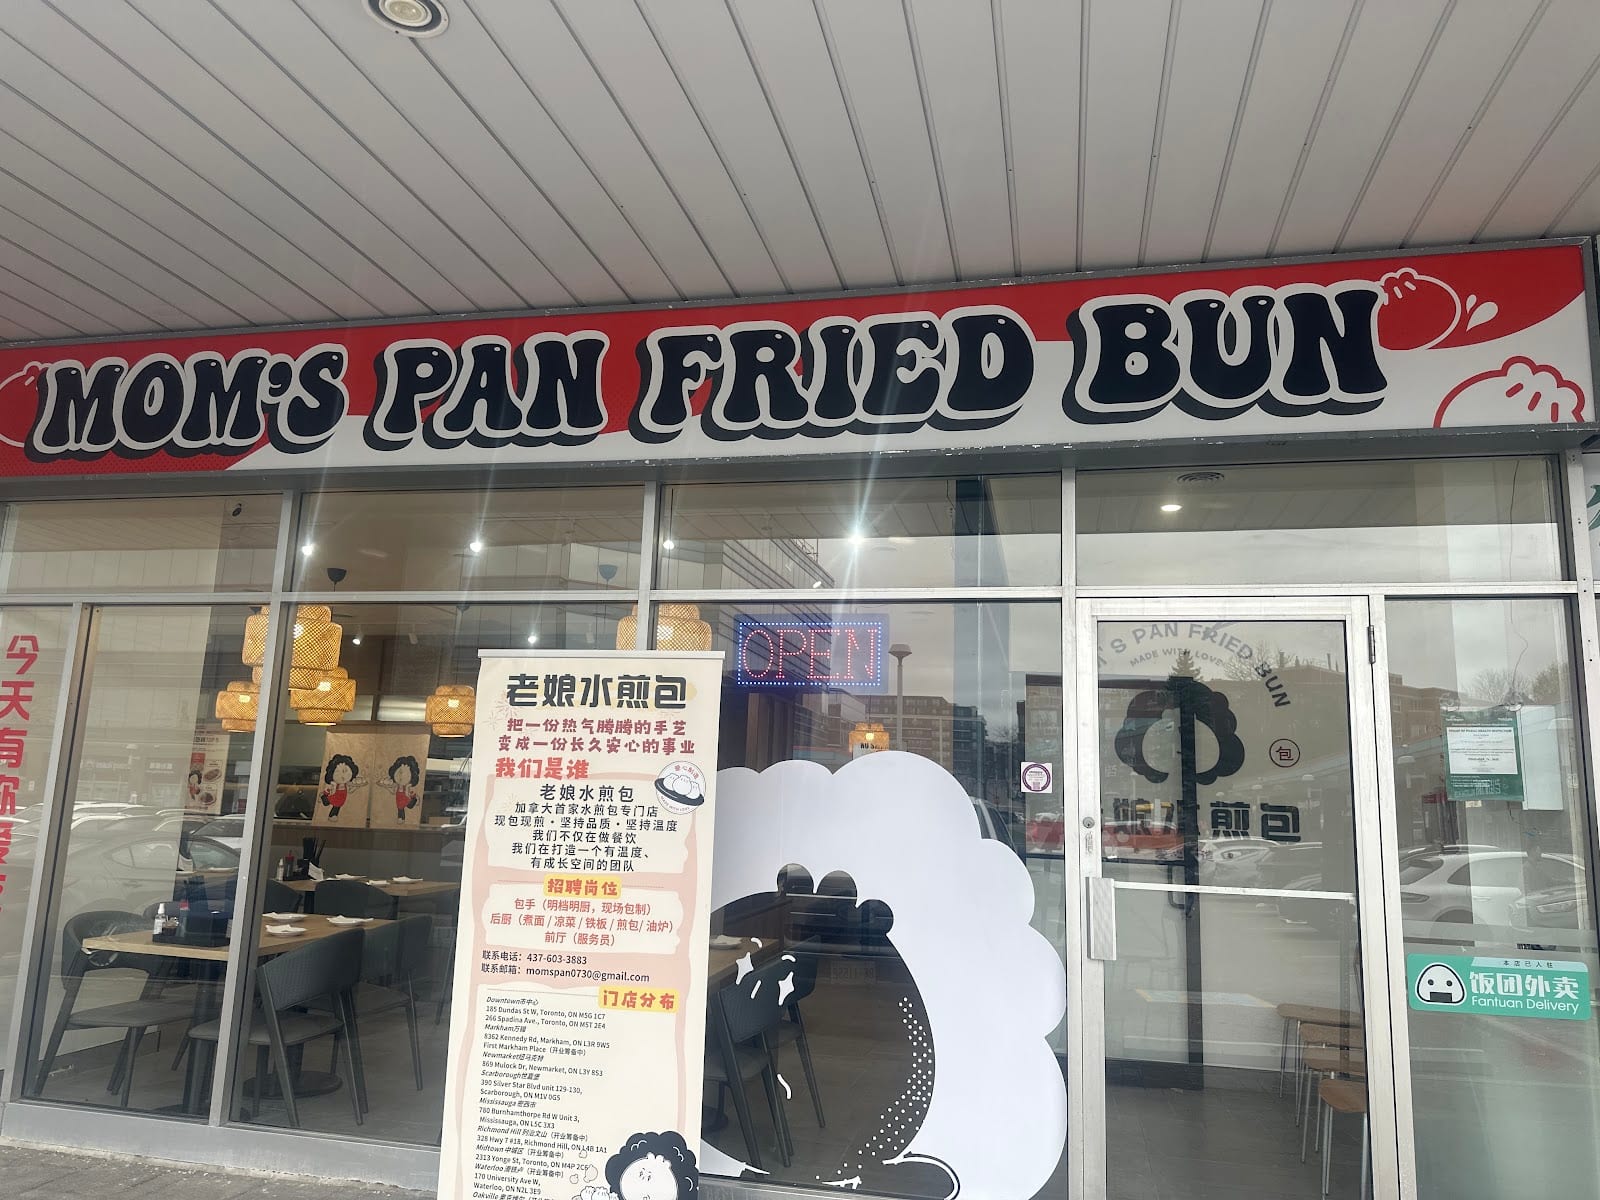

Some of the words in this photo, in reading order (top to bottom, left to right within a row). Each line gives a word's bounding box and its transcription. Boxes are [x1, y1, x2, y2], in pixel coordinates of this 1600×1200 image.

[25, 344, 348, 460] MOM'S
[363, 329, 608, 452] PAN
[628, 305, 1035, 443] FRIED
[1061, 279, 1388, 425] BUN
[742, 629, 878, 679] OPEN
[1130, 650, 1159, 667] MADE
[1132, 622, 1178, 644] PAN
[1188, 623, 1253, 660] FRIED
[1254, 661, 1292, 708] BUN
[506, 674, 687, 709] 老娘水煎包
[507, 718, 687, 736] 把一份热气腾腾的手艺
[498, 736, 695, 755] 变成一份长久安心的事业
[495, 757, 590, 780] 我们是谁
[540, 784, 634, 802] 老娘水煎包
[514, 803, 658, 818] 加拿大首家水煎包专门店
[532, 829, 637, 845] 我们不仅在做餐饮
[530, 857, 635, 873] 有成长空间的团队
[547, 878, 619, 897] 招聘岗位
[526, 952, 588, 965] 437-603-3883
[526, 966, 650, 983] momspan0730@gmail.com
[1469, 971, 1579, 1000] 饭团外卖
[602, 990, 676, 1010] 门店分布
[1471, 995, 1523, 1009] Fantuan
[1526, 998, 1579, 1015] Delivery
[498, 1007, 522, 1015] Dundas
[568, 1011, 578, 1019] ON
[569, 1020, 579, 1028] ON
[498, 1043, 528, 1051] Markham
[529, 1045, 546, 1053] Place
[500, 1034, 528, 1044] Kennedy
[572, 1039, 582, 1047] ON
[494, 1061, 517, 1069] Mulock
[568, 1067, 578, 1075] ON
[493, 1080, 512, 1088] Silver
[526, 1082, 541, 1090] Blvd
[541, 1084, 555, 1092] unit
[519, 1119, 530, 1127] ON
[524, 1139, 557, 1148] Richmond
